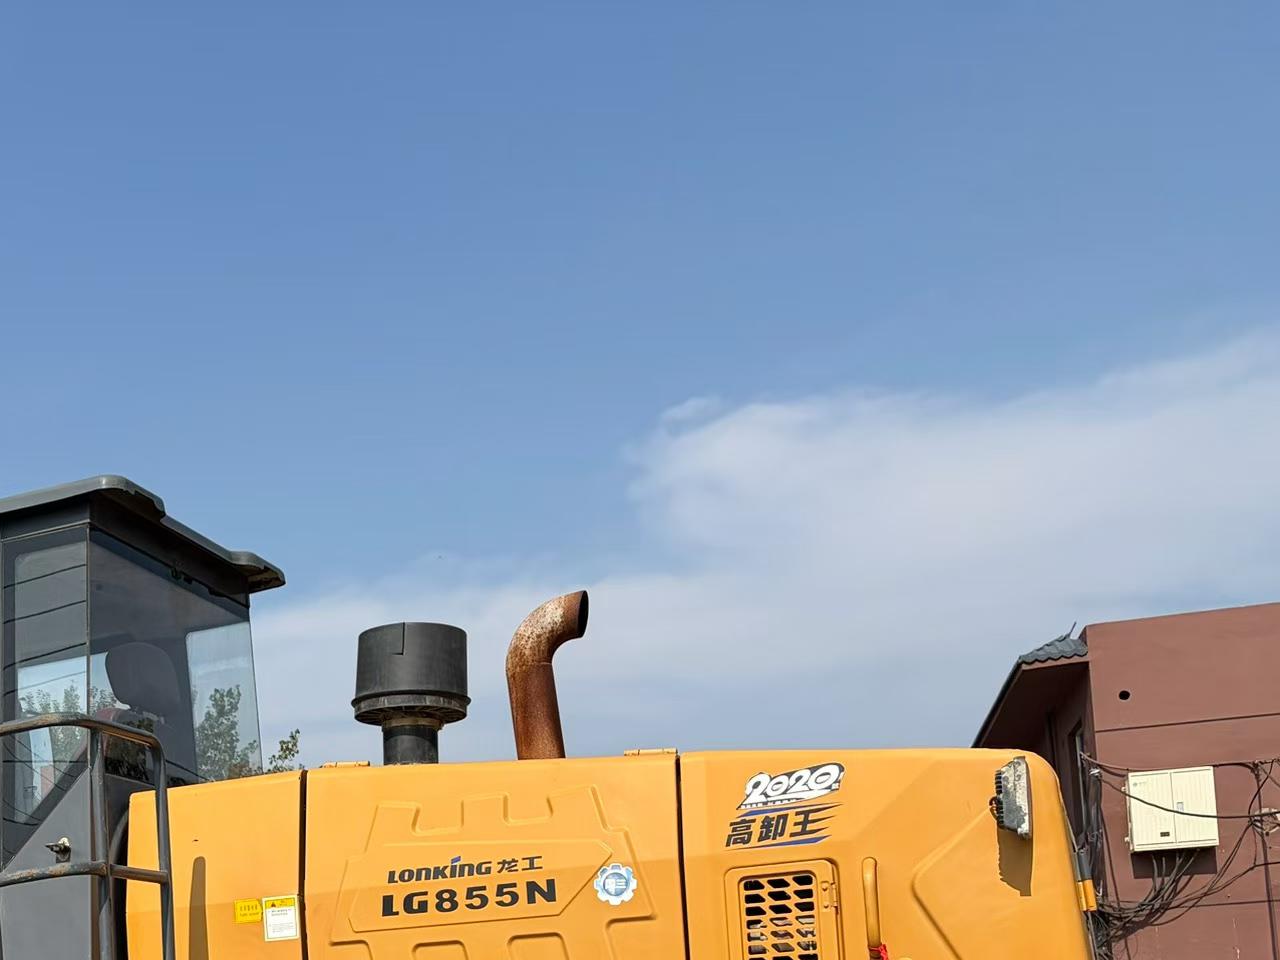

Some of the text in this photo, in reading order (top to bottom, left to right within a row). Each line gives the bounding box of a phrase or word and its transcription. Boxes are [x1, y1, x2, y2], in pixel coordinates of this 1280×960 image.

[744, 764, 841, 807] 2020
[725, 803, 843, 848] 高卸王
[497, 855, 543, 874] 龙工
[381, 879, 557, 917] LG855N
